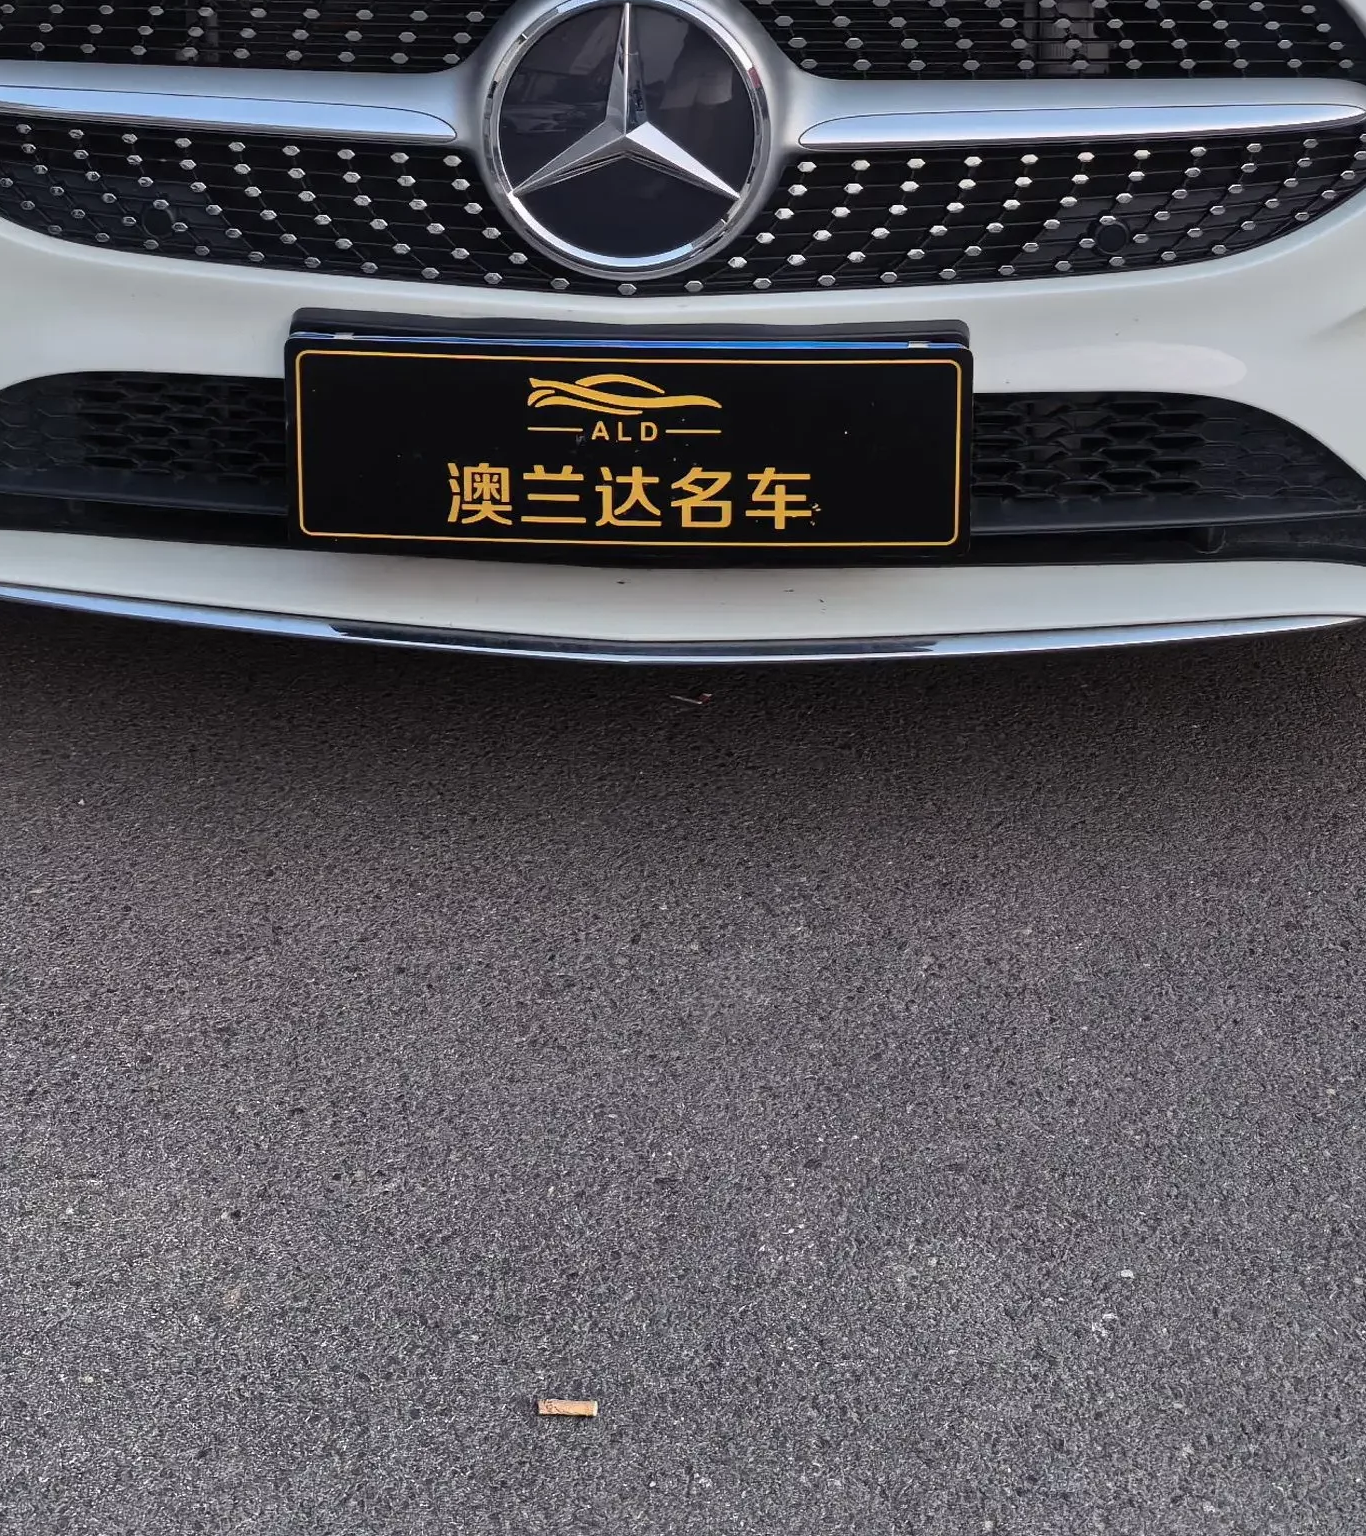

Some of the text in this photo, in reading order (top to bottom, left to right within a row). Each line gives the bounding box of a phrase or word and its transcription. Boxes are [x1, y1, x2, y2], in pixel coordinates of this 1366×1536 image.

[591, 420, 659, 442] ALD
[447, 462, 813, 530] 澳兰达名车
